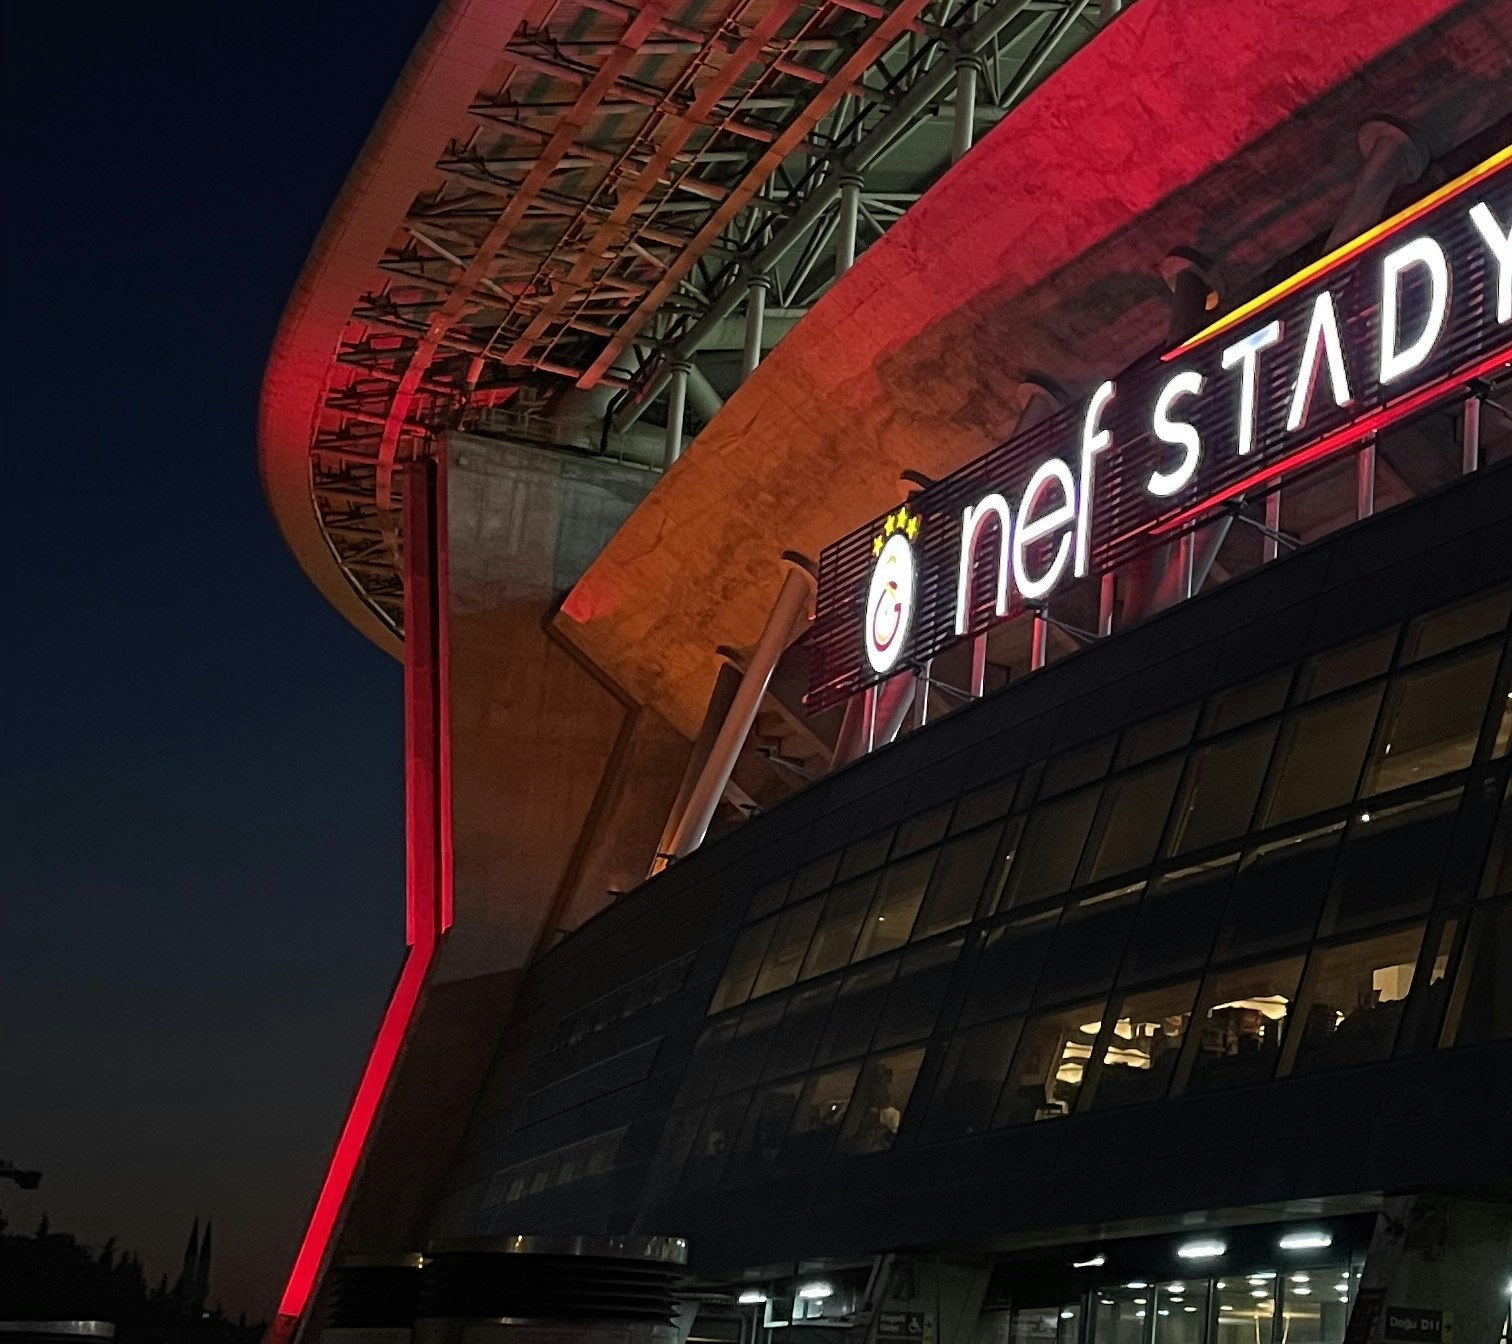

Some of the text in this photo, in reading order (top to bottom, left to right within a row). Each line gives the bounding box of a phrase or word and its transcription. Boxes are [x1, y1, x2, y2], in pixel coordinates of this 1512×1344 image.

[954, 380, 1116, 637] nef
[1389, 1315, 1441, 1331] Doğu D11
